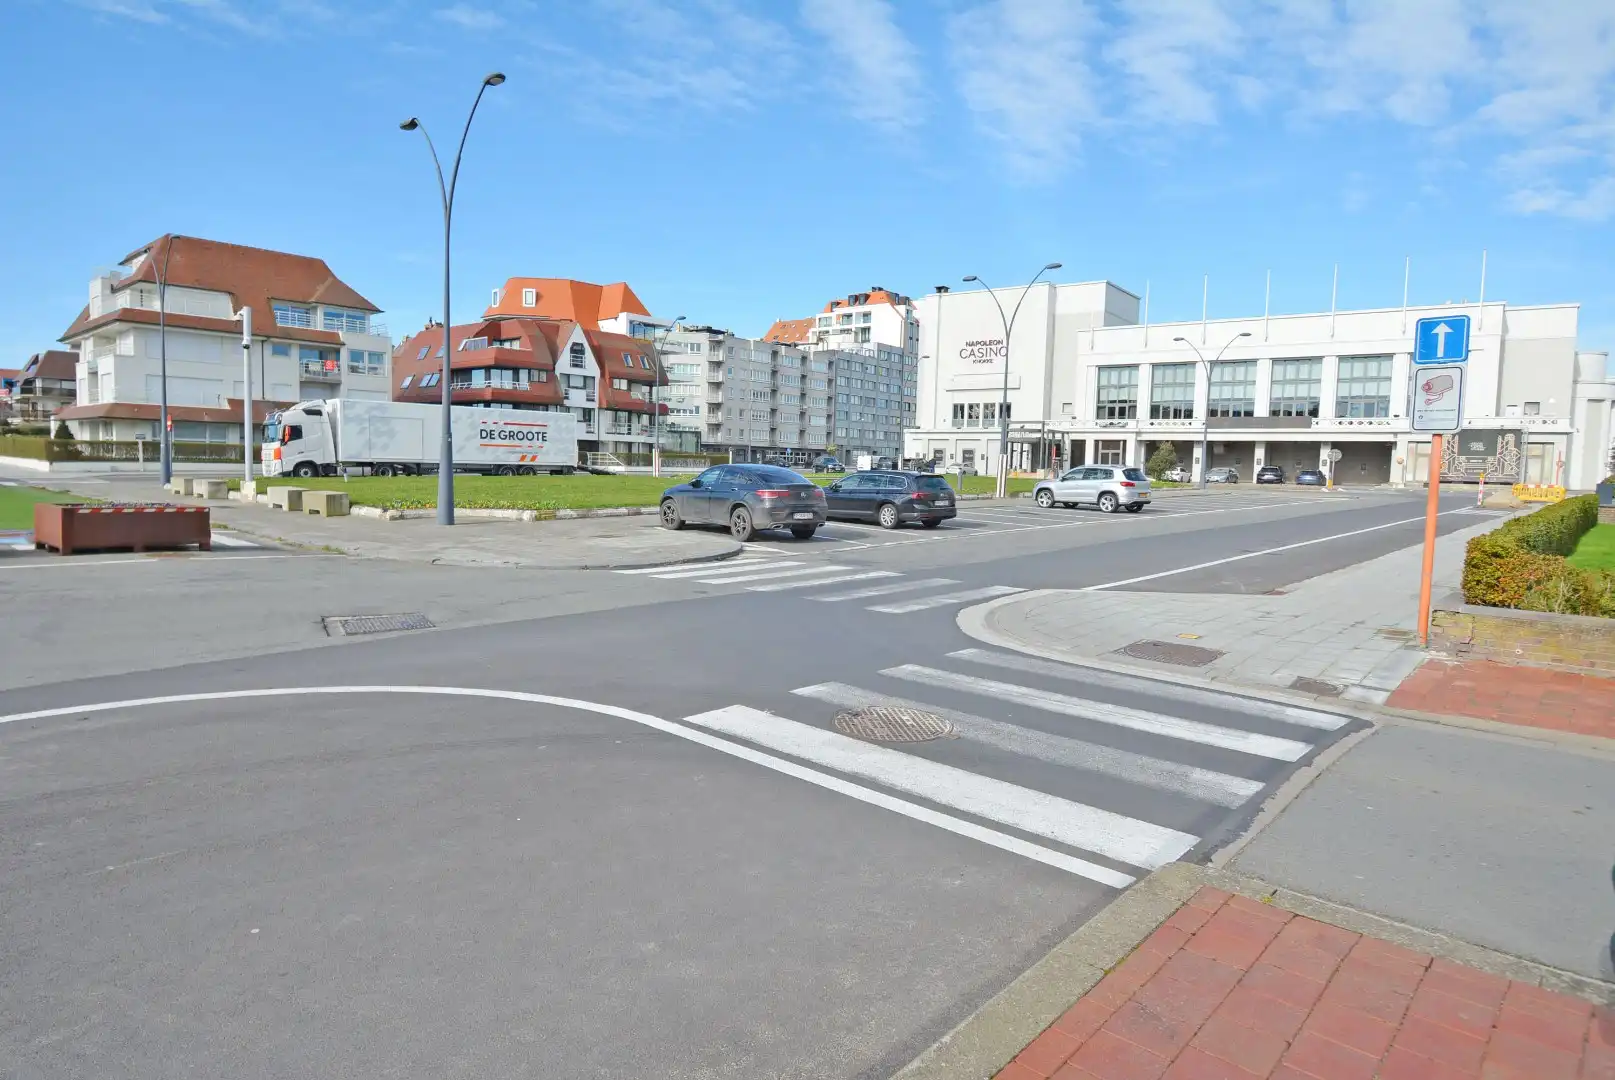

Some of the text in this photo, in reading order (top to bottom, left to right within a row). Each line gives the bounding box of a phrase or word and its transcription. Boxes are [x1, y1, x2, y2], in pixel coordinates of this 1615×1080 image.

[965, 339, 1004, 347] NAPOLEON
[959, 346, 1008, 359] CASINO
[479, 428, 548, 442] DE GROOTE
